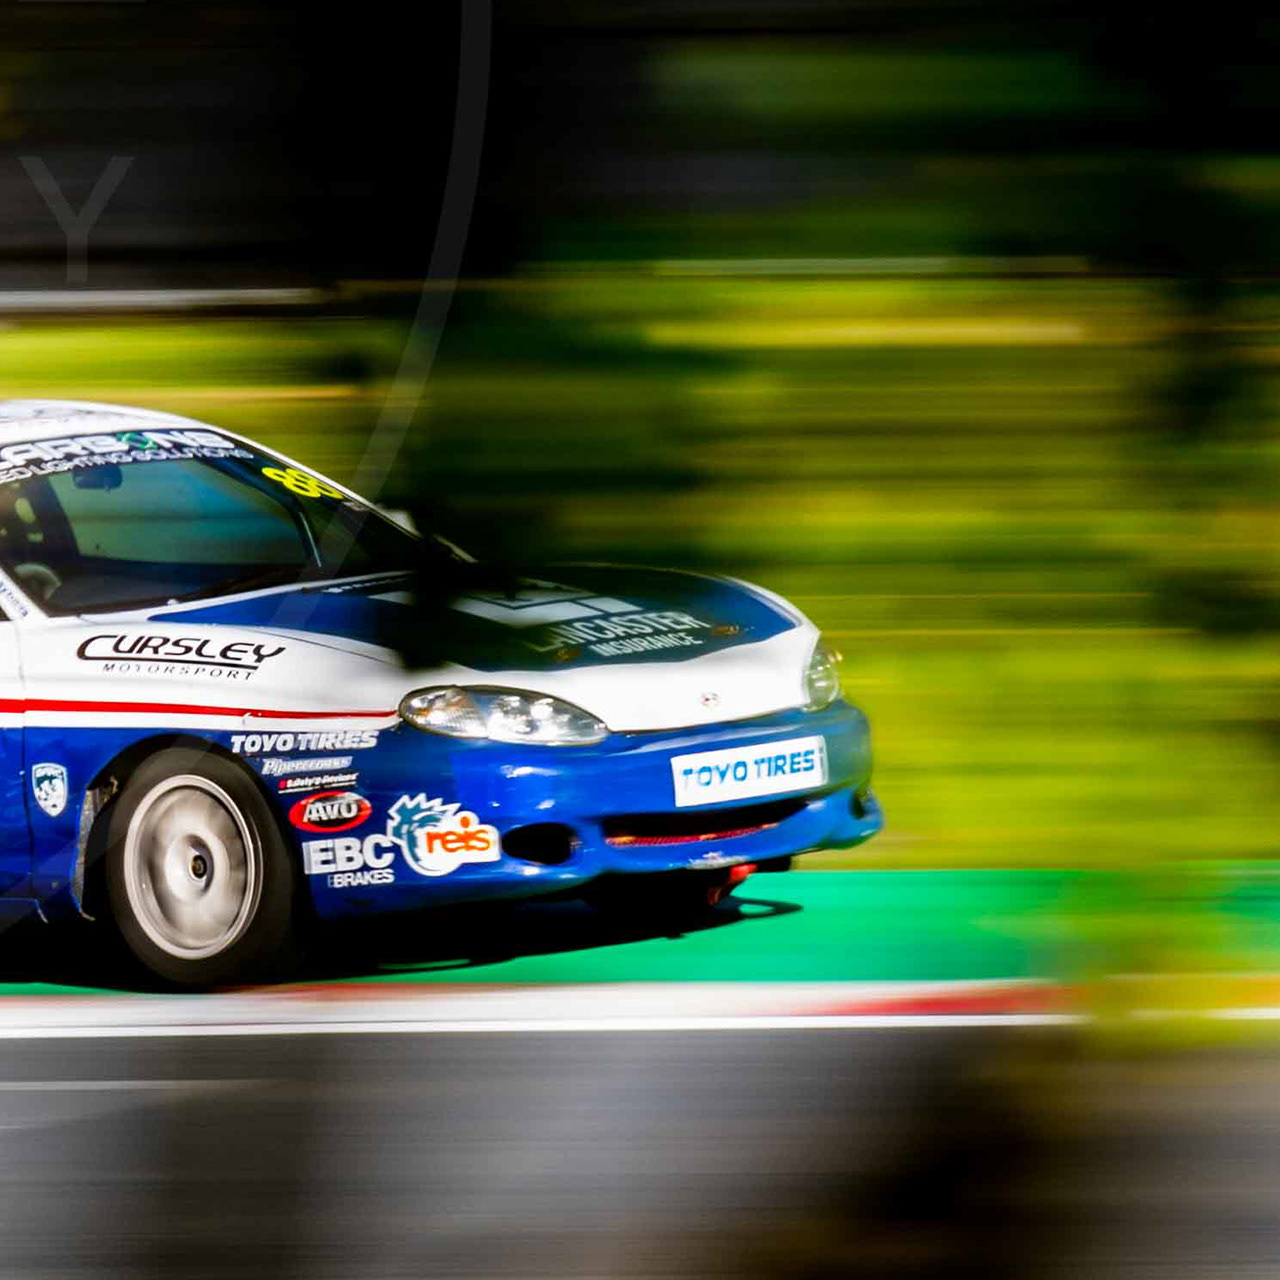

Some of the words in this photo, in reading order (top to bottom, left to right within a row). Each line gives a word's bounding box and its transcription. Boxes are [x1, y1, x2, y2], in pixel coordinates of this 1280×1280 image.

[77, 633, 287, 664] CURSLEY
[590, 631, 705, 657] INSURANCE
[102, 663, 255, 681] MOTORSPORT
[297, 730, 379, 751] TIRES
[753, 748, 816, 779] TIRES
[425, 816, 491, 854] reis
[302, 833, 396, 875] EBC
[328, 869, 396, 889] BRAKES
